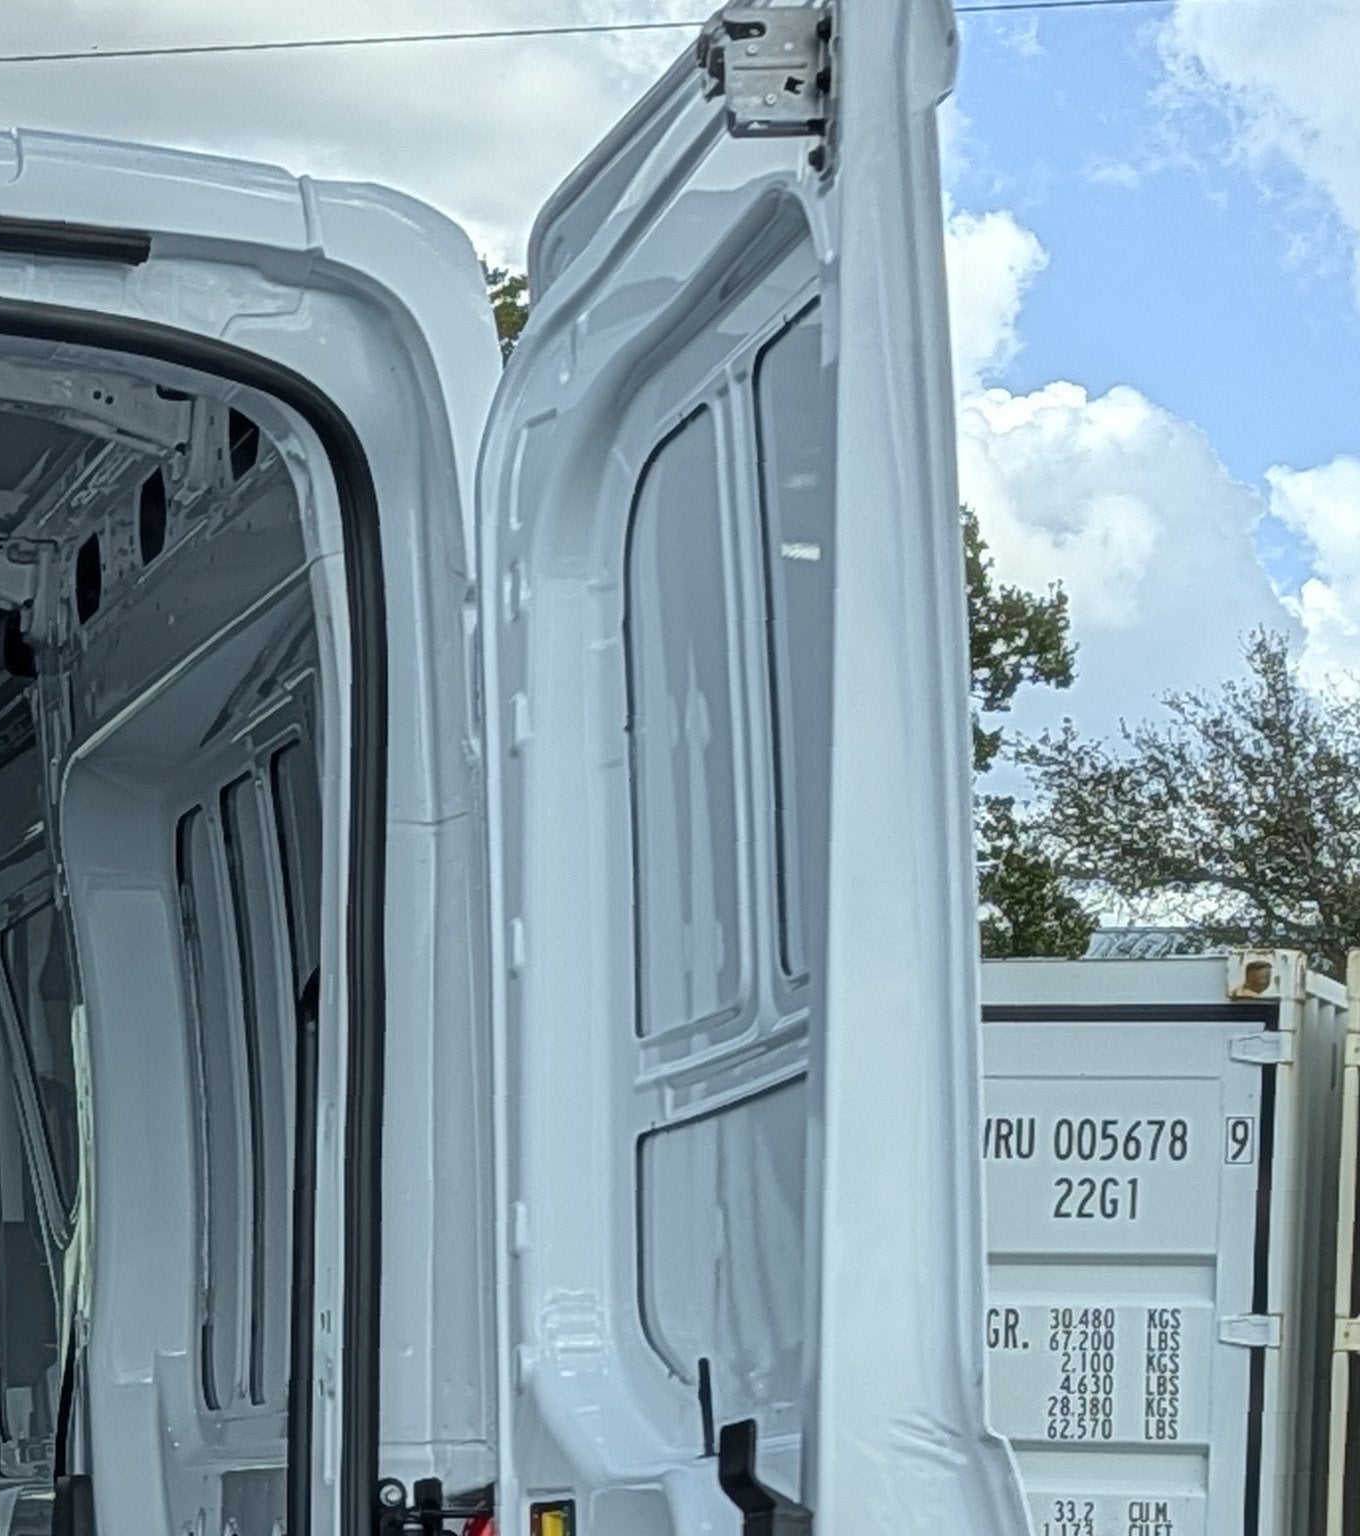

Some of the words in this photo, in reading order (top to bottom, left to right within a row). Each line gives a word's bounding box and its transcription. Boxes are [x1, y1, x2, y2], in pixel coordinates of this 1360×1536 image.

[1053, 1119, 1188, 1161] 005678
[1231, 1120, 1249, 1160] 9
[1052, 1177, 1139, 1219] 22G1
[986, 1308, 1029, 1349] GR.
[1050, 1308, 1115, 1329] 30.480
[1147, 1309, 1181, 1329] KGS
[1049, 1330, 1115, 1351] 67.200
[1146, 1331, 1180, 1351] LBS
[1061, 1352, 1114, 1373] 2.100
[1145, 1353, 1179, 1374] KGS
[1060, 1374, 1113, 1395] 4.630
[1145, 1375, 1179, 1396] LBS
[1047, 1396, 1113, 1417] 28.380
[1145, 1397, 1179, 1418] KGS
[1047, 1419, 1112, 1440] 62.570
[1144, 1420, 1178, 1440] LBS
[1054, 1501, 1094, 1522] 33.2
